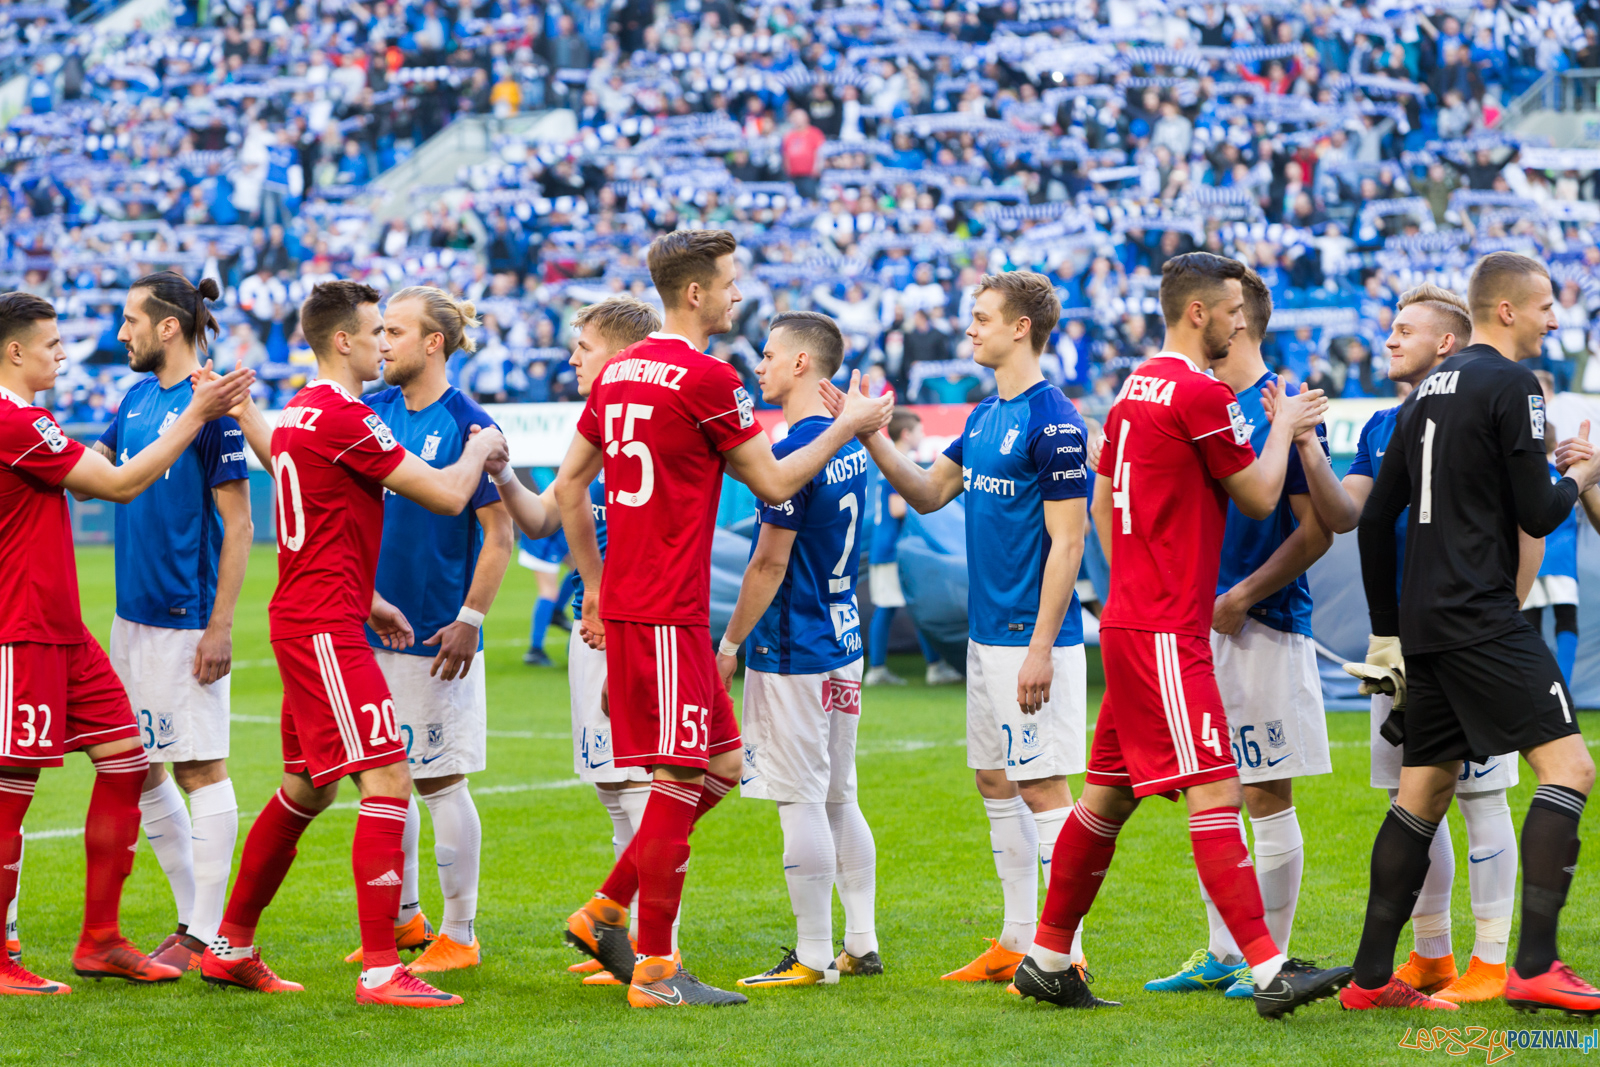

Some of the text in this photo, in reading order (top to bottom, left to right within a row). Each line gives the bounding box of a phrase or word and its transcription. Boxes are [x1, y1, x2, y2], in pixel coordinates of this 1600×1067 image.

[605, 403, 655, 507] 55
[1112, 419, 1132, 535] 4
[1420, 418, 1436, 523] 1
[271, 451, 305, 553] 0
[974, 474, 1015, 496] AFORTI
[17, 704, 53, 747] 32
[360, 698, 399, 746] 20
[1550, 681, 1572, 723] 1
[136, 709, 155, 749] 3
[681, 704, 708, 752] 55
[1201, 712, 1223, 757] 4
